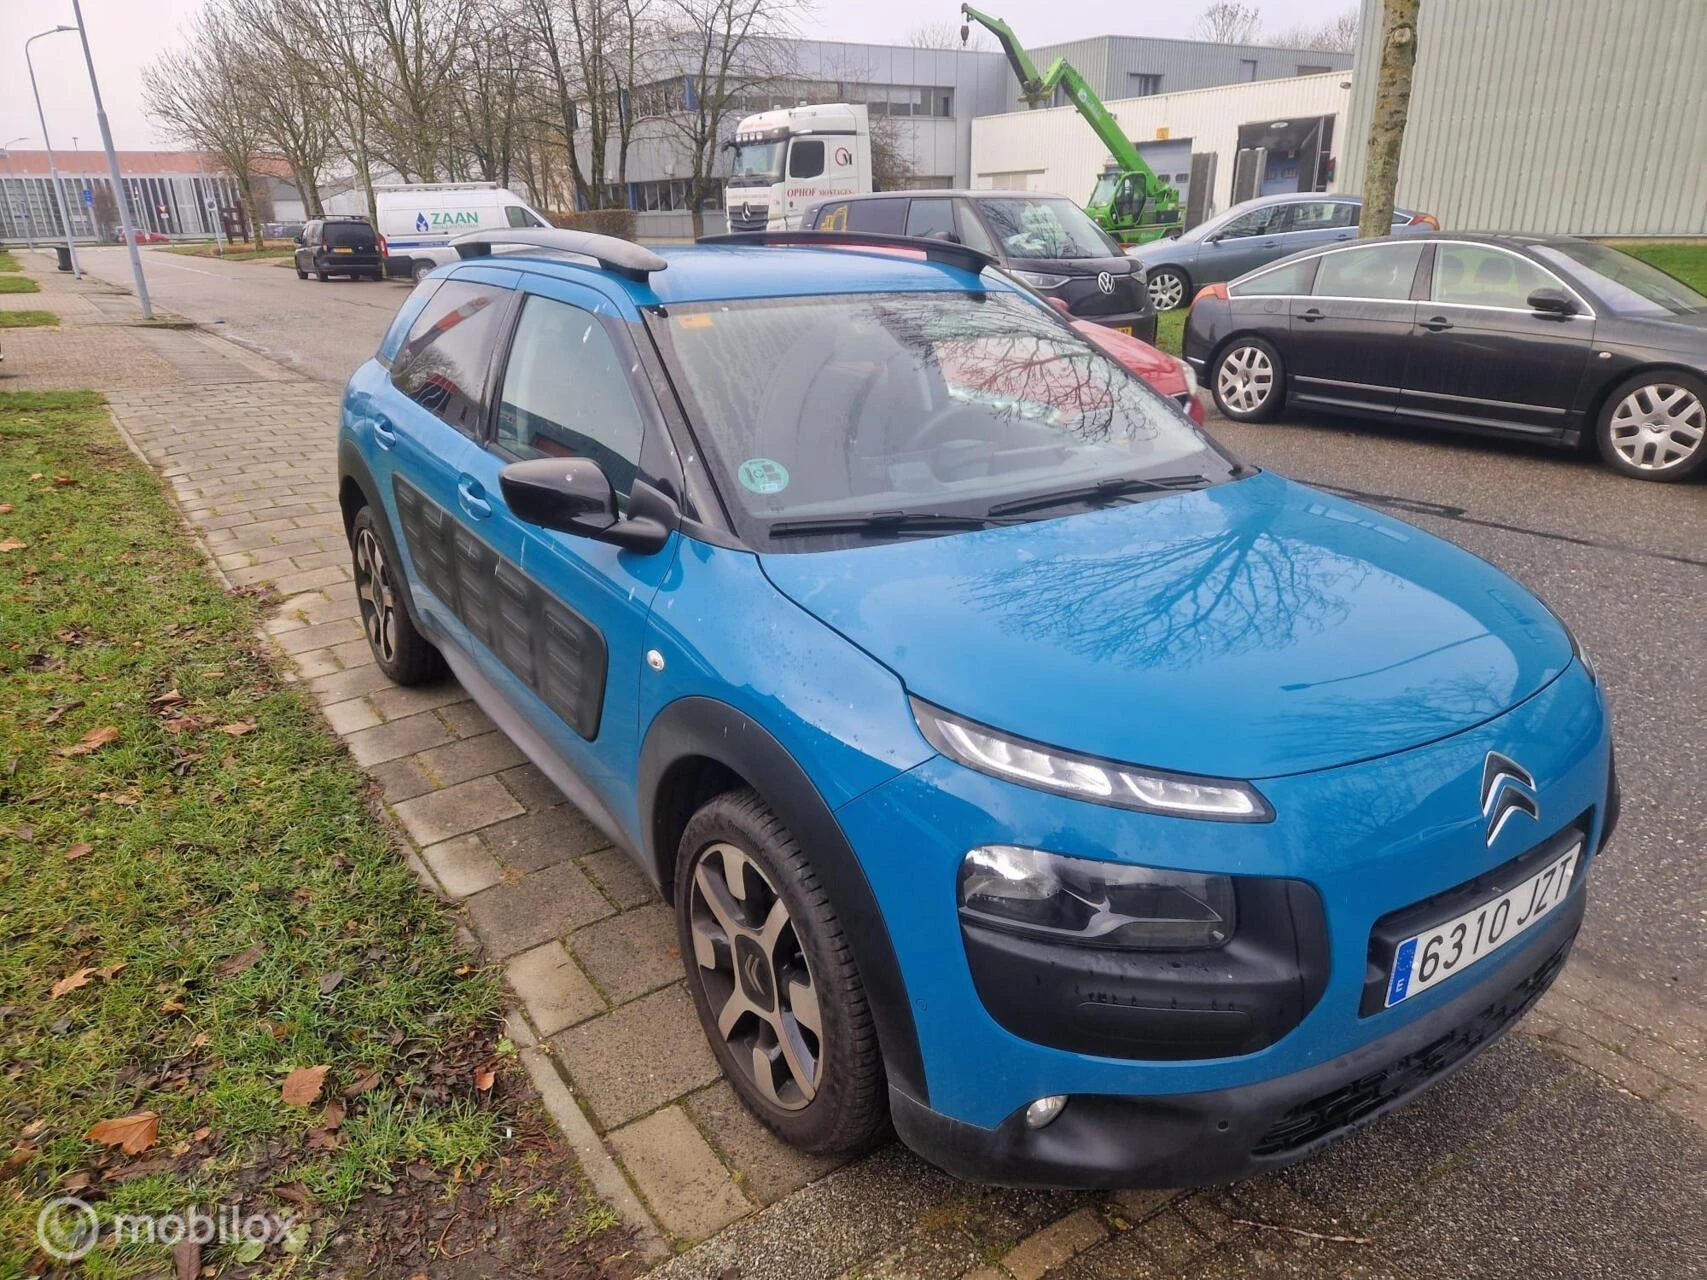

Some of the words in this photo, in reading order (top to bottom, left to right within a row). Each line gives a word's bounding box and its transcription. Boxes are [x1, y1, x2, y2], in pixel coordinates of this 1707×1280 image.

[787, 187, 816, 198] OPHOF
[430, 211, 479, 225] ZAAN
[1395, 978, 1405, 993] E
[1418, 898, 1511, 983] 6310
[1517, 856, 1573, 926] JZT
